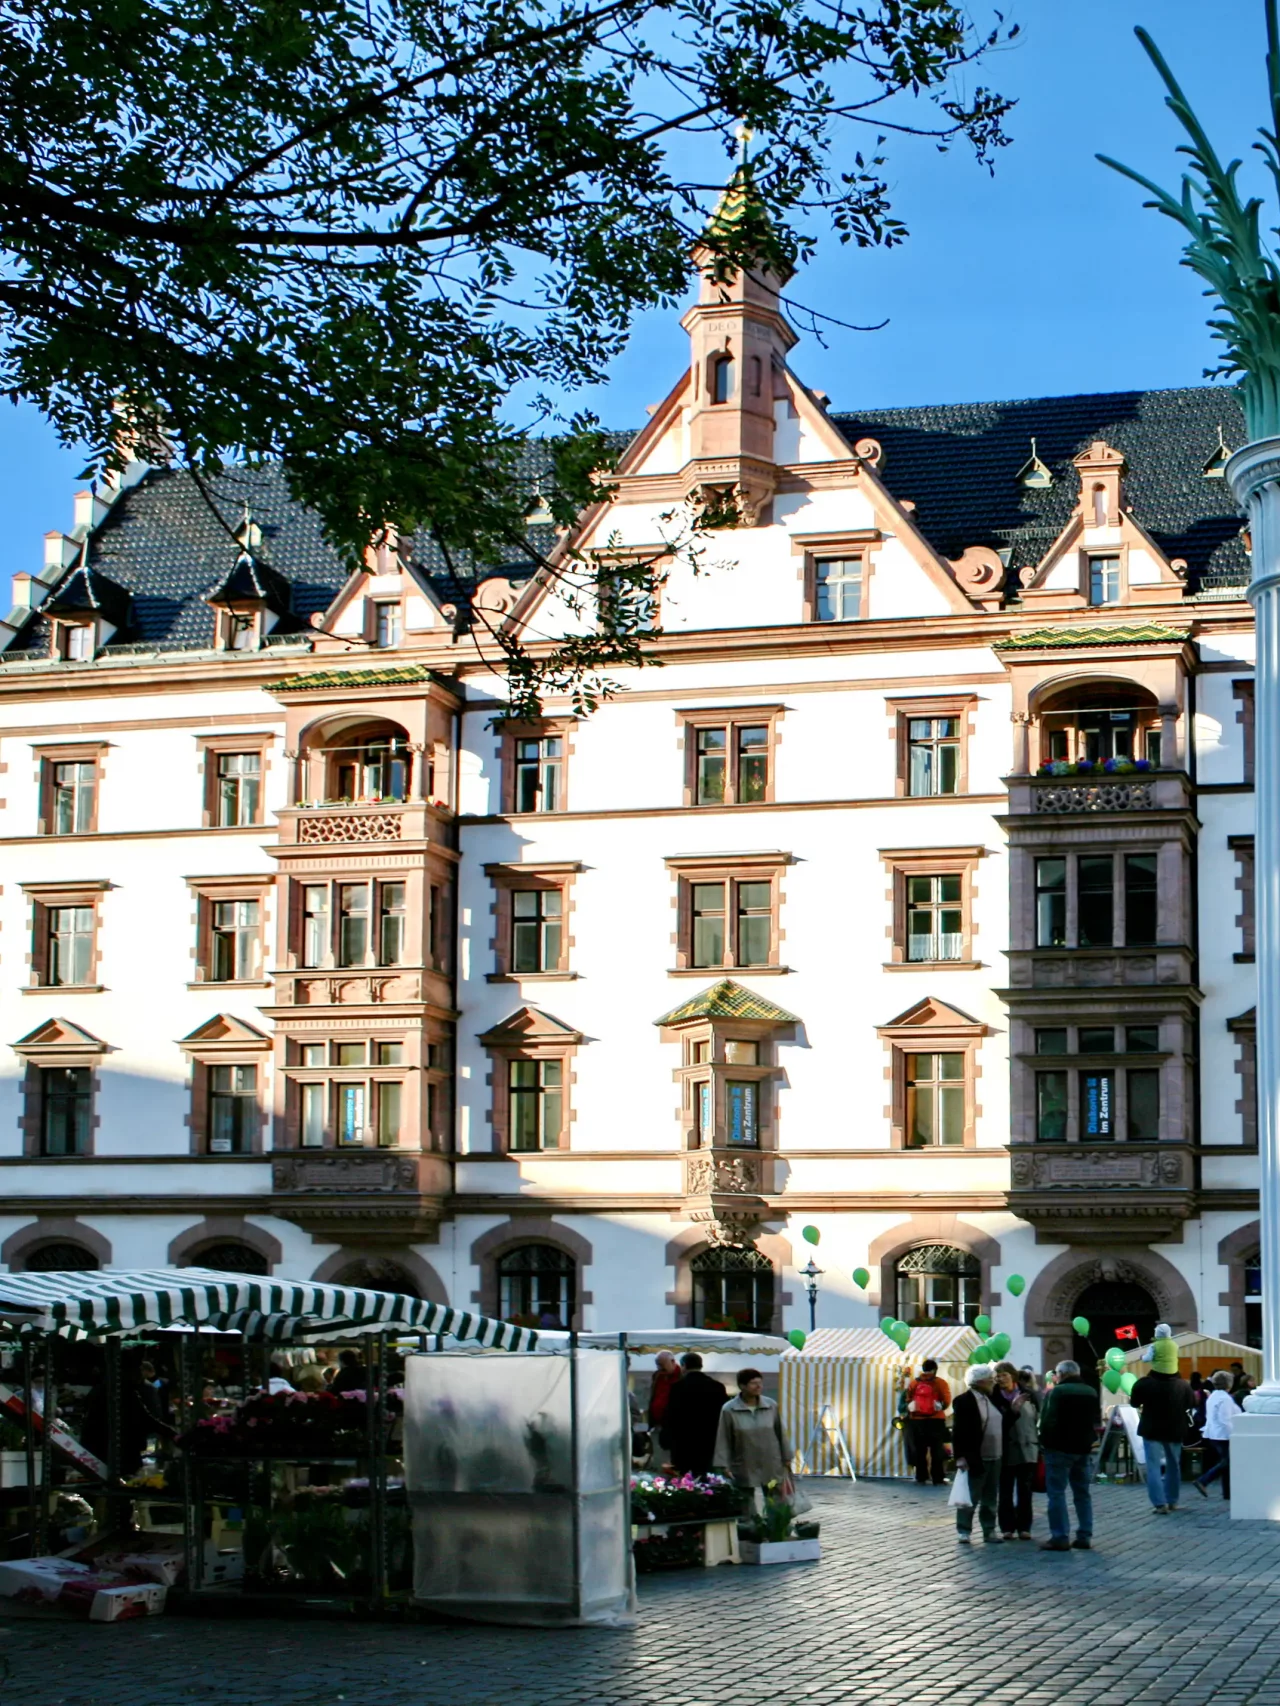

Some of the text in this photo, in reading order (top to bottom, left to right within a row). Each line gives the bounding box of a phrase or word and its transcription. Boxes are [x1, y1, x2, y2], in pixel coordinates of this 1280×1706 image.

[743, 1088, 752, 1141] im Zentrum
[1087, 1089, 1097, 1133] Diakonie
[1100, 1078, 1109, 1133] im Zentrum
